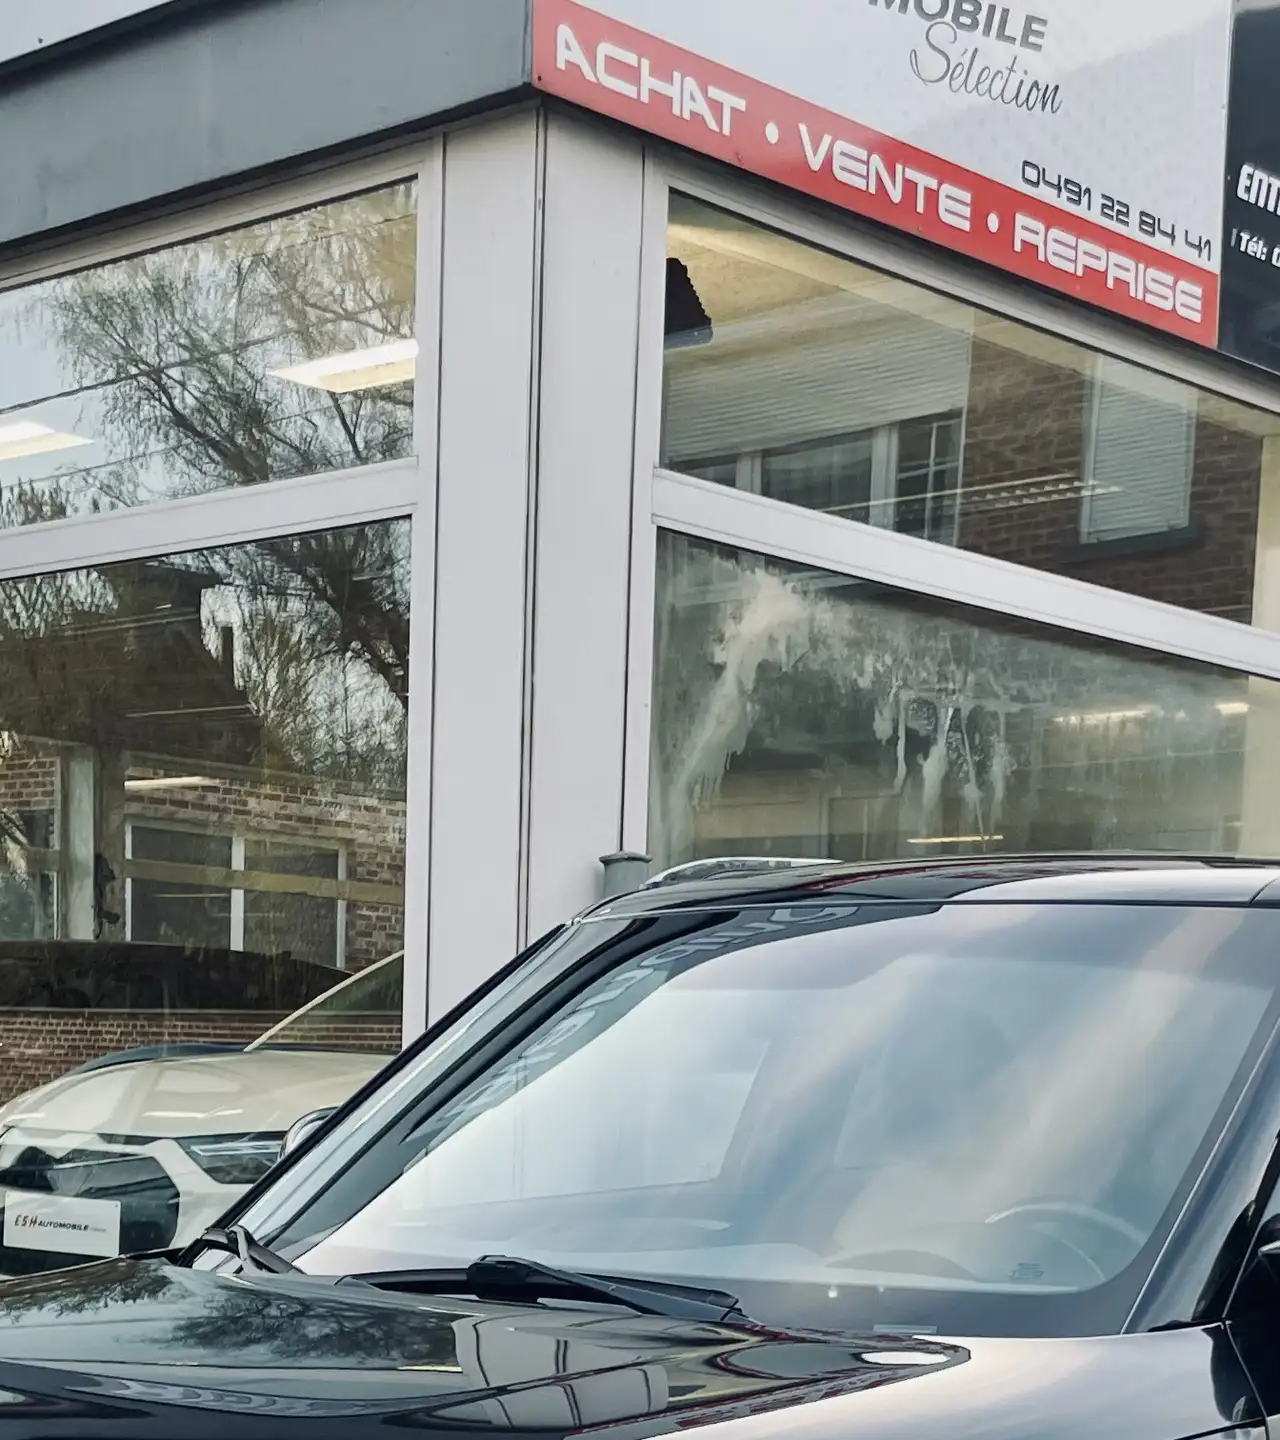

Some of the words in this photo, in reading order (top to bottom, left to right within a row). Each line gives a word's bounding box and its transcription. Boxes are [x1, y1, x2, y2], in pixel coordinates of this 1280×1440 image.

[909, 21, 1063, 114] Sélection
[556, 23, 747, 138] ACHAT
[798, 123, 972, 232] VENTE
[1014, 212, 1203, 324] REPRISE
[1022, 160, 1091, 211] 0491
[1100, 193, 1129, 227] 22
[1139, 210, 1176, 246] 84
[1185, 229, 1211, 262] 41
[1239, 231, 1268, 261] Tél:
